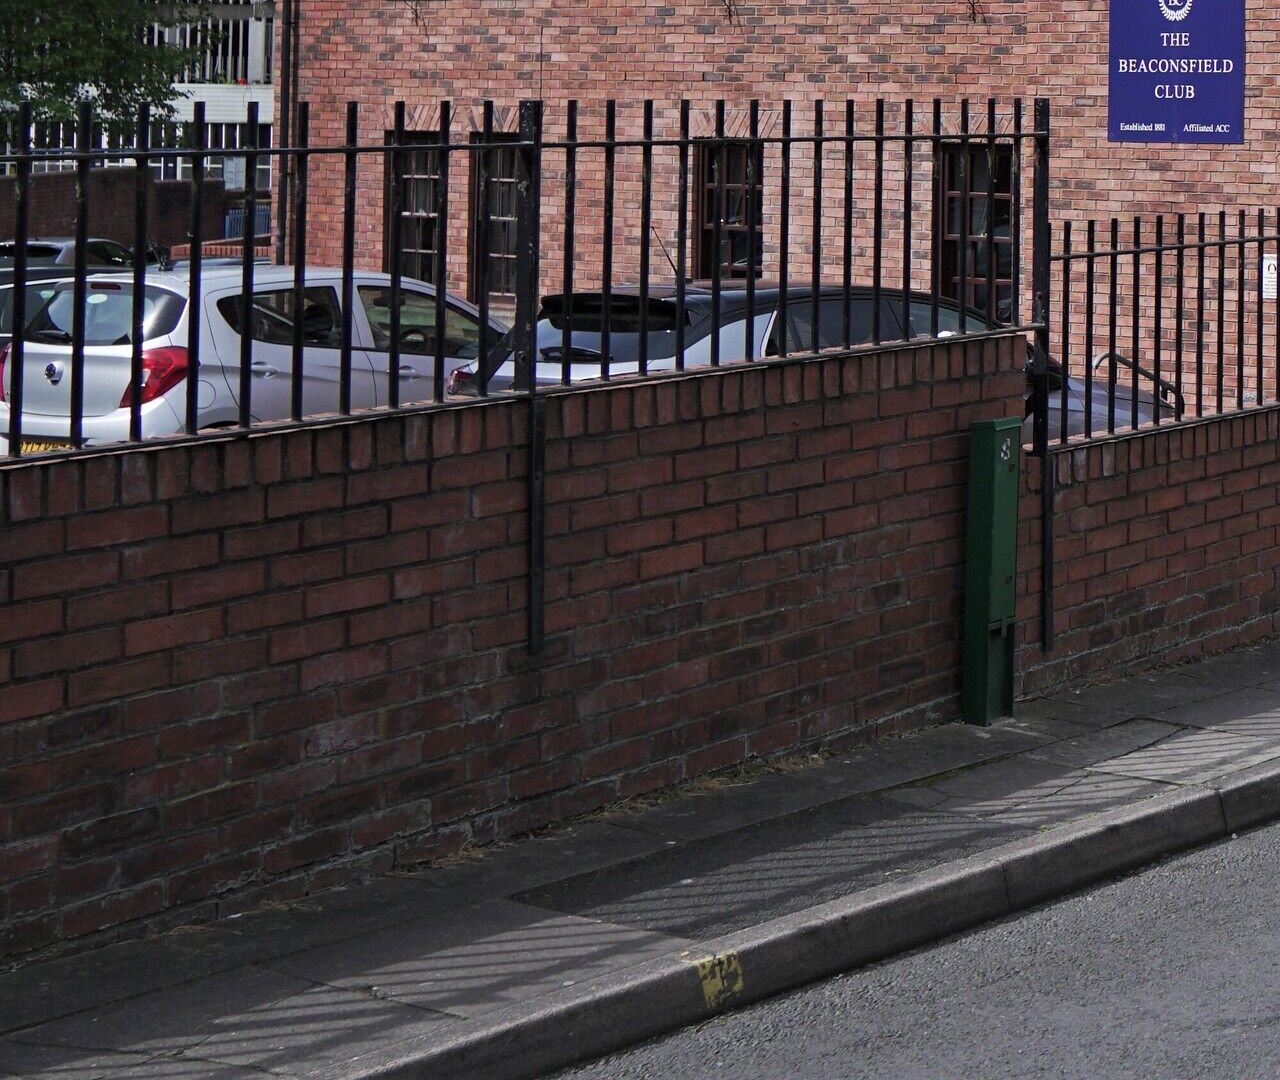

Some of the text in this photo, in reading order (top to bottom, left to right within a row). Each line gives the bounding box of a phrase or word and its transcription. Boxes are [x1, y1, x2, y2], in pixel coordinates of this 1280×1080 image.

[1160, 32, 1190, 47] THE
[1118, 59, 1234, 73] BEACONSFIELD
[1154, 84, 1195, 99] CLUB
[1120, 123, 1153, 132] Established
[1183, 124, 1230, 133] Affiliated ACC
